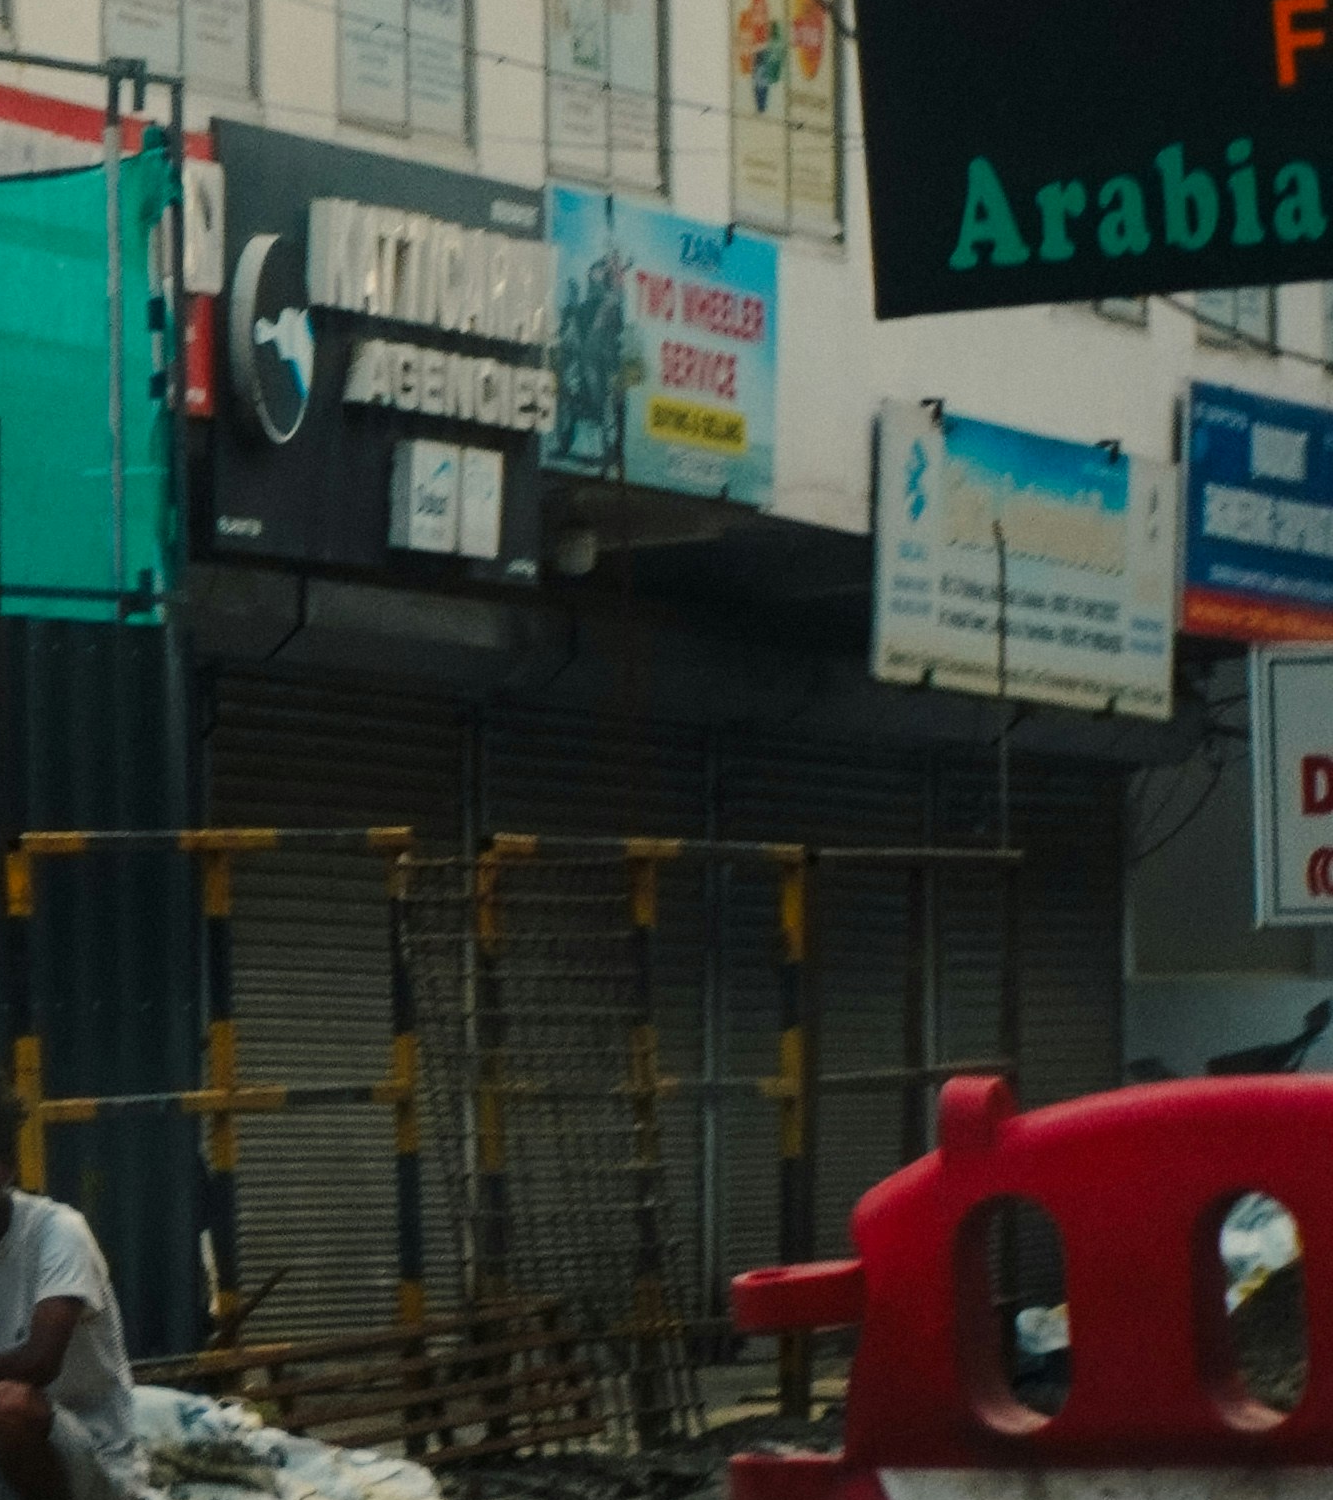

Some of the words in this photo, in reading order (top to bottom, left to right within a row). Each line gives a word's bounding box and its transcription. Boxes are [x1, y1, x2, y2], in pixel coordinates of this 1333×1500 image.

[948, 137, 1328, 271] Arabia
[636, 269, 675, 323] TWO
[683, 282, 765, 345] WHEELER
[341, 336, 559, 433] AGENCIES
[660, 339, 737, 400] SERVICE
